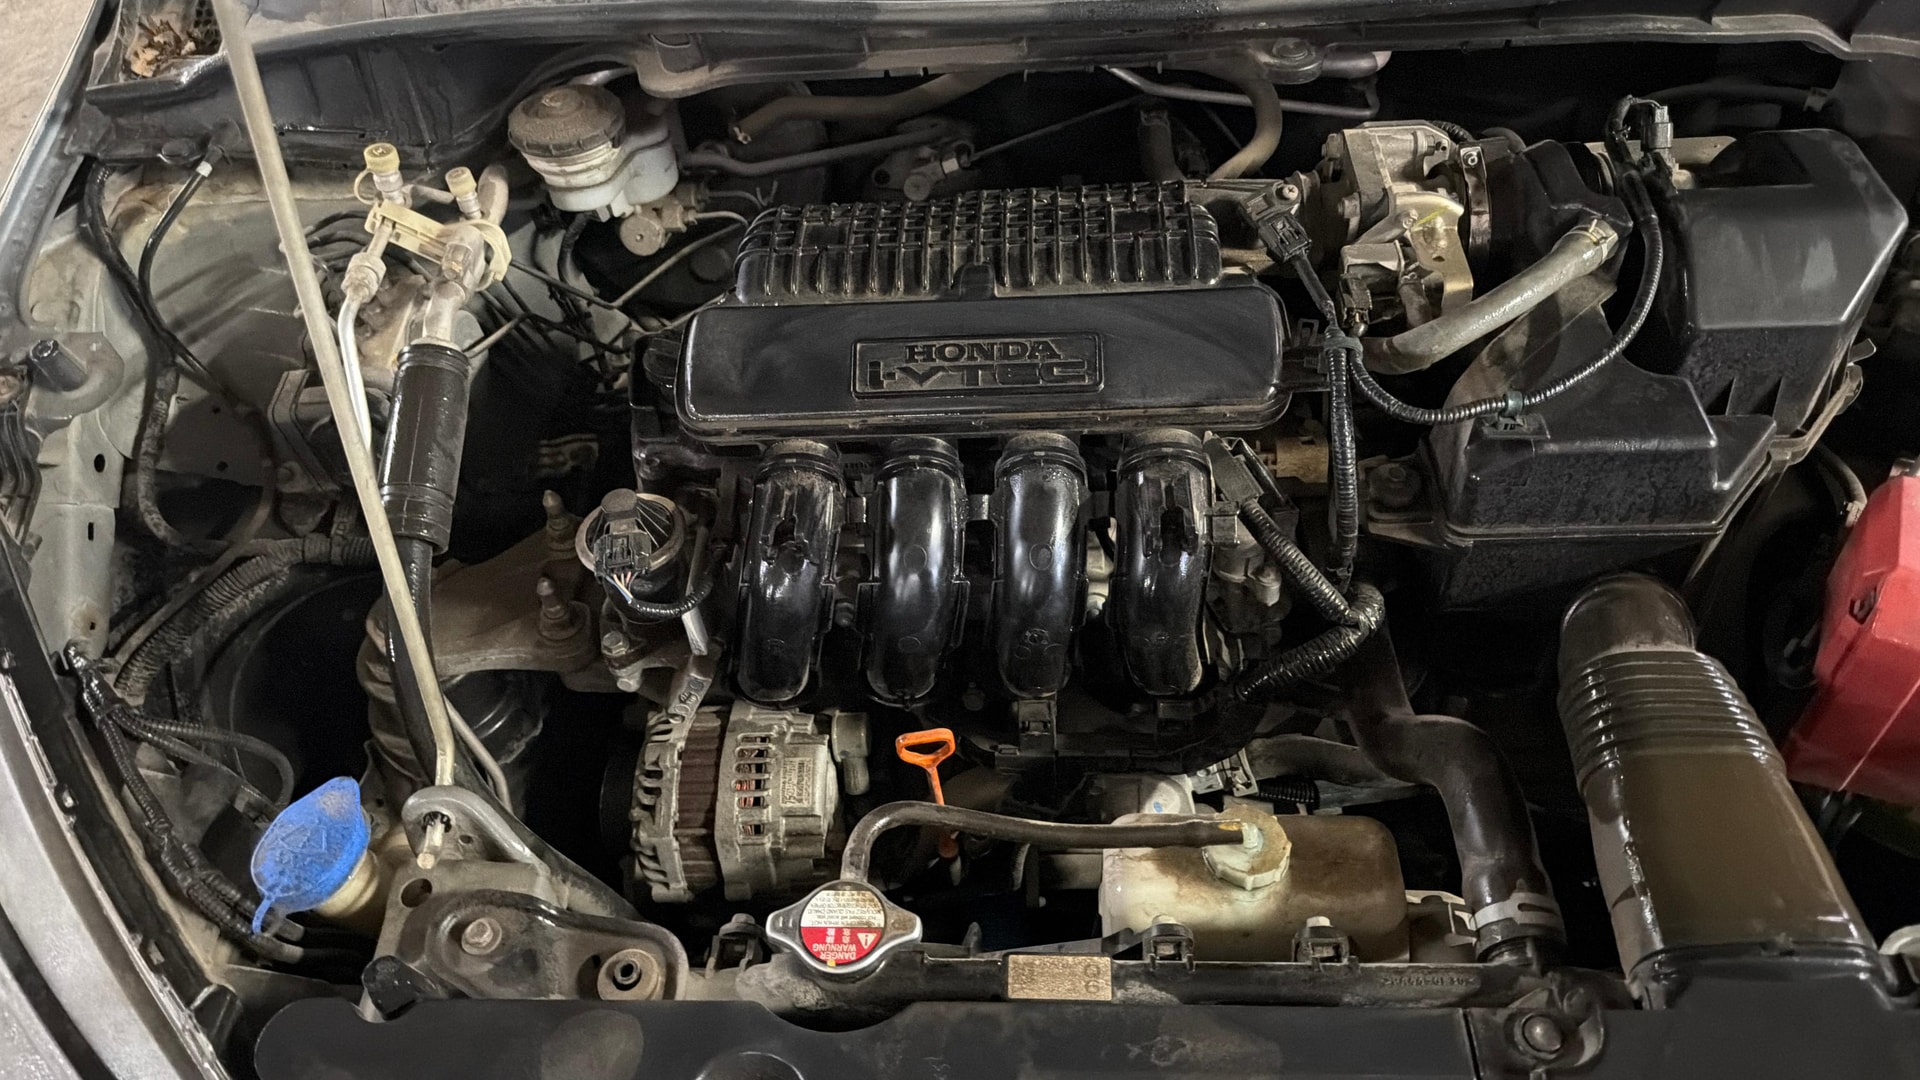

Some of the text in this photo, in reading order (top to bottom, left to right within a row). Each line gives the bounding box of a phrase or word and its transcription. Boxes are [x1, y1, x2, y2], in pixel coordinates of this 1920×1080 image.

[904, 340, 1062, 363] HONDA
[813, 944, 856, 952] WARNUNG
[820, 952, 856, 960] DANGER
